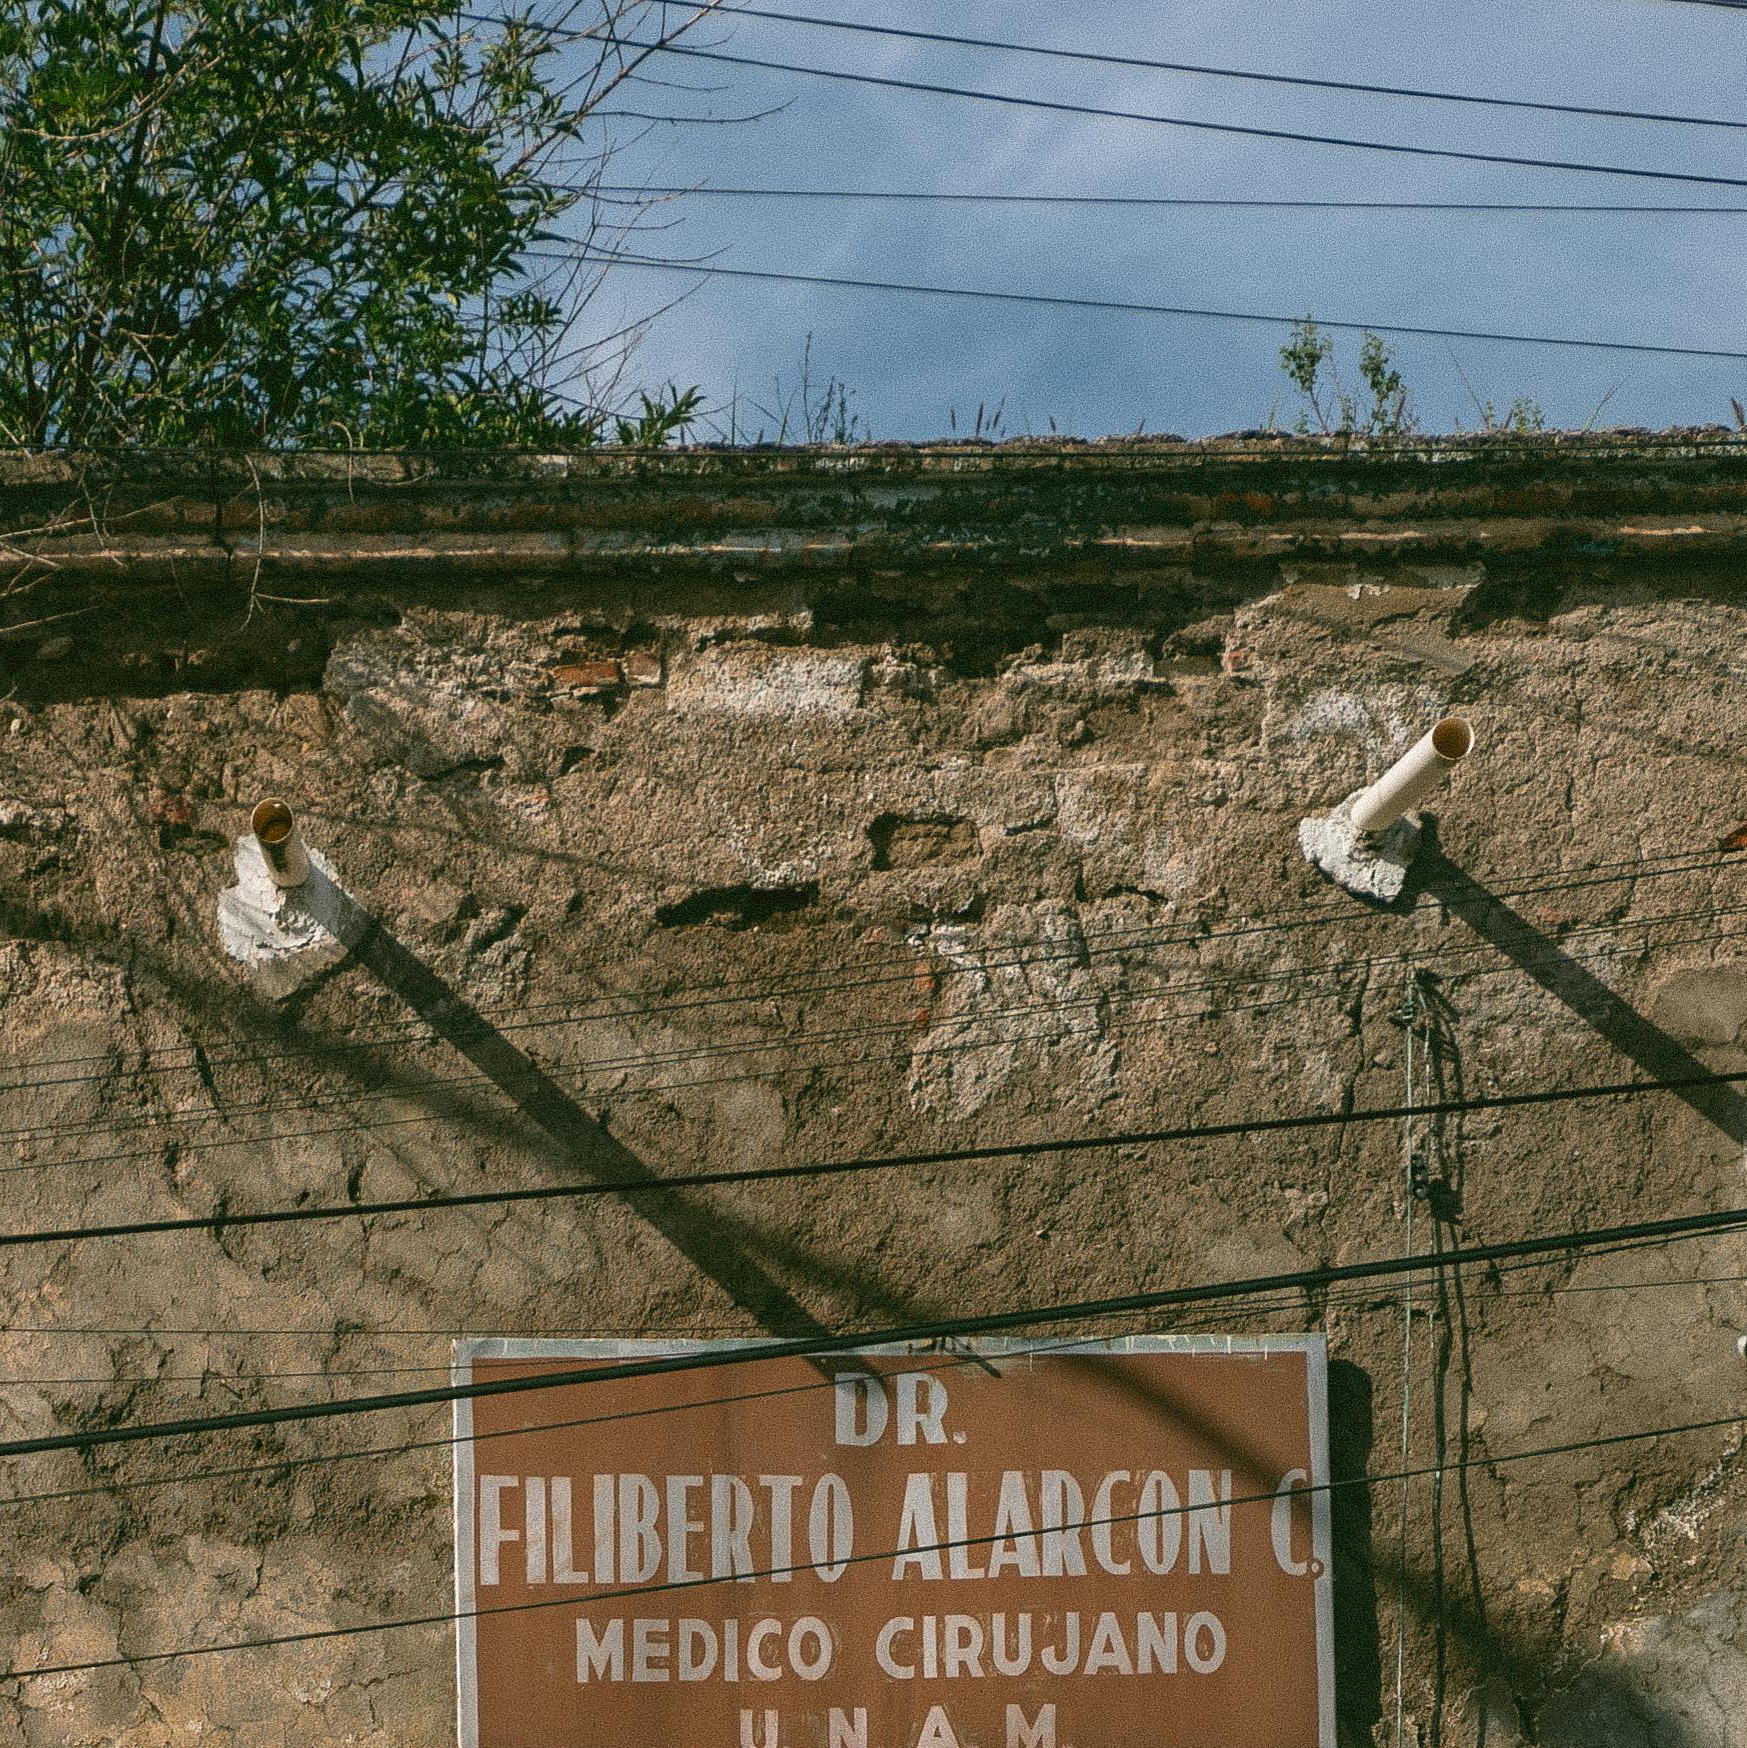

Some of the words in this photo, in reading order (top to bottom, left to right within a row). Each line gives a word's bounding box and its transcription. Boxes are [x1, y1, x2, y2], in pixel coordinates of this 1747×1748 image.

[834, 1371, 968, 1447] DR.
[479, 1473, 854, 1586] FILIBERTO
[891, 1468, 1233, 1581] ALARCON
[574, 1616, 834, 1685] MEDICO
[874, 1610, 1229, 1681] CIRUJANO
